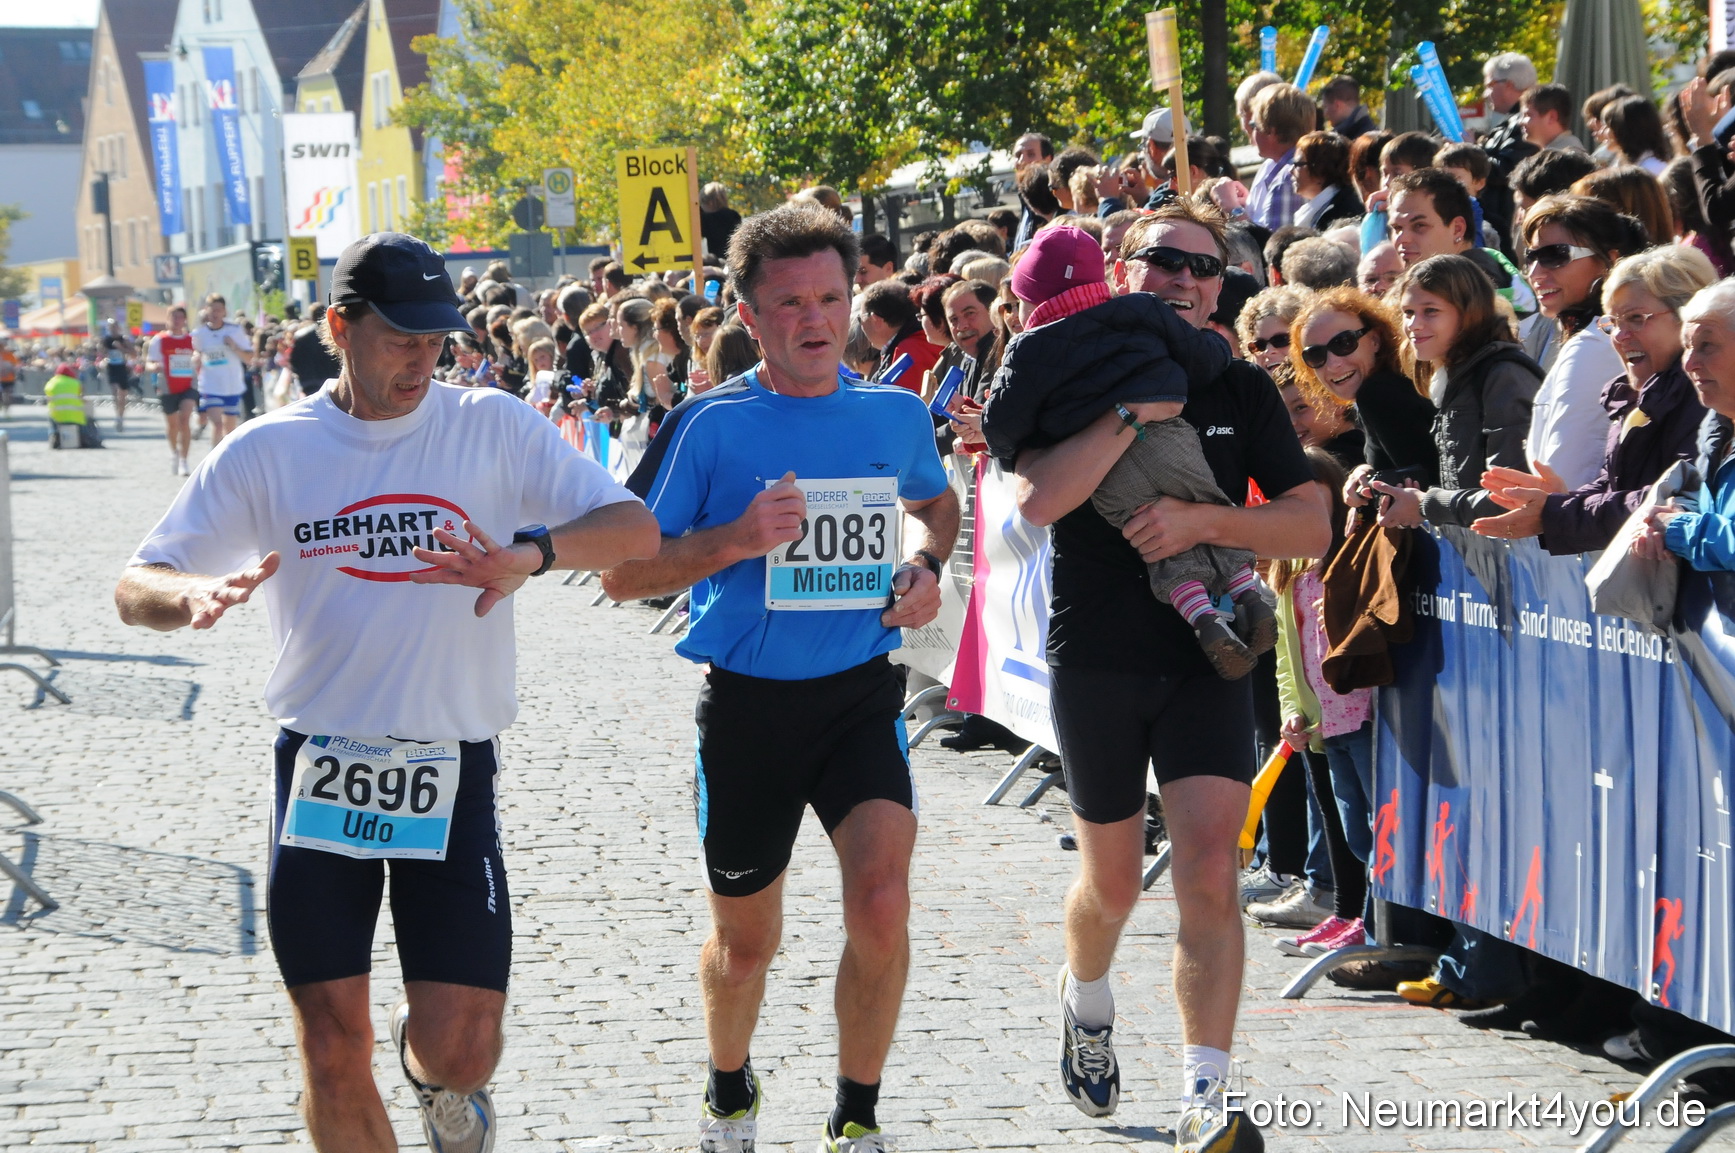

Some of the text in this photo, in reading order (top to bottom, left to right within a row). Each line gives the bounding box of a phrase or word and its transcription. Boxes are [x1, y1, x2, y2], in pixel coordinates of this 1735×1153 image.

[222, 114, 241, 176] RUPPERT
[291, 142, 351, 159] swn
[626, 154, 688, 177] Block
[639, 187, 683, 245] A
[296, 249, 312, 270] B
[129, 309, 139, 321] C
[806, 491, 891, 502] EIDERER BOCK
[294, 510, 455, 544] GERHART &
[785, 513, 886, 562] 2083
[300, 543, 359, 559] Autohaus
[774, 556, 780, 564] B
[793, 566, 881, 593] Michael
[1436, 590, 1455, 622] und
[1459, 592, 1498, 630] Türme
[1520, 603, 1549, 638] sind
[1552, 616, 1593, 648] unsere
[332, 735, 446, 758] PFLEIDERER BOCK
[298, 788, 304, 798] A
[310, 755, 440, 814] 2696
[343, 810, 394, 843] Udo
